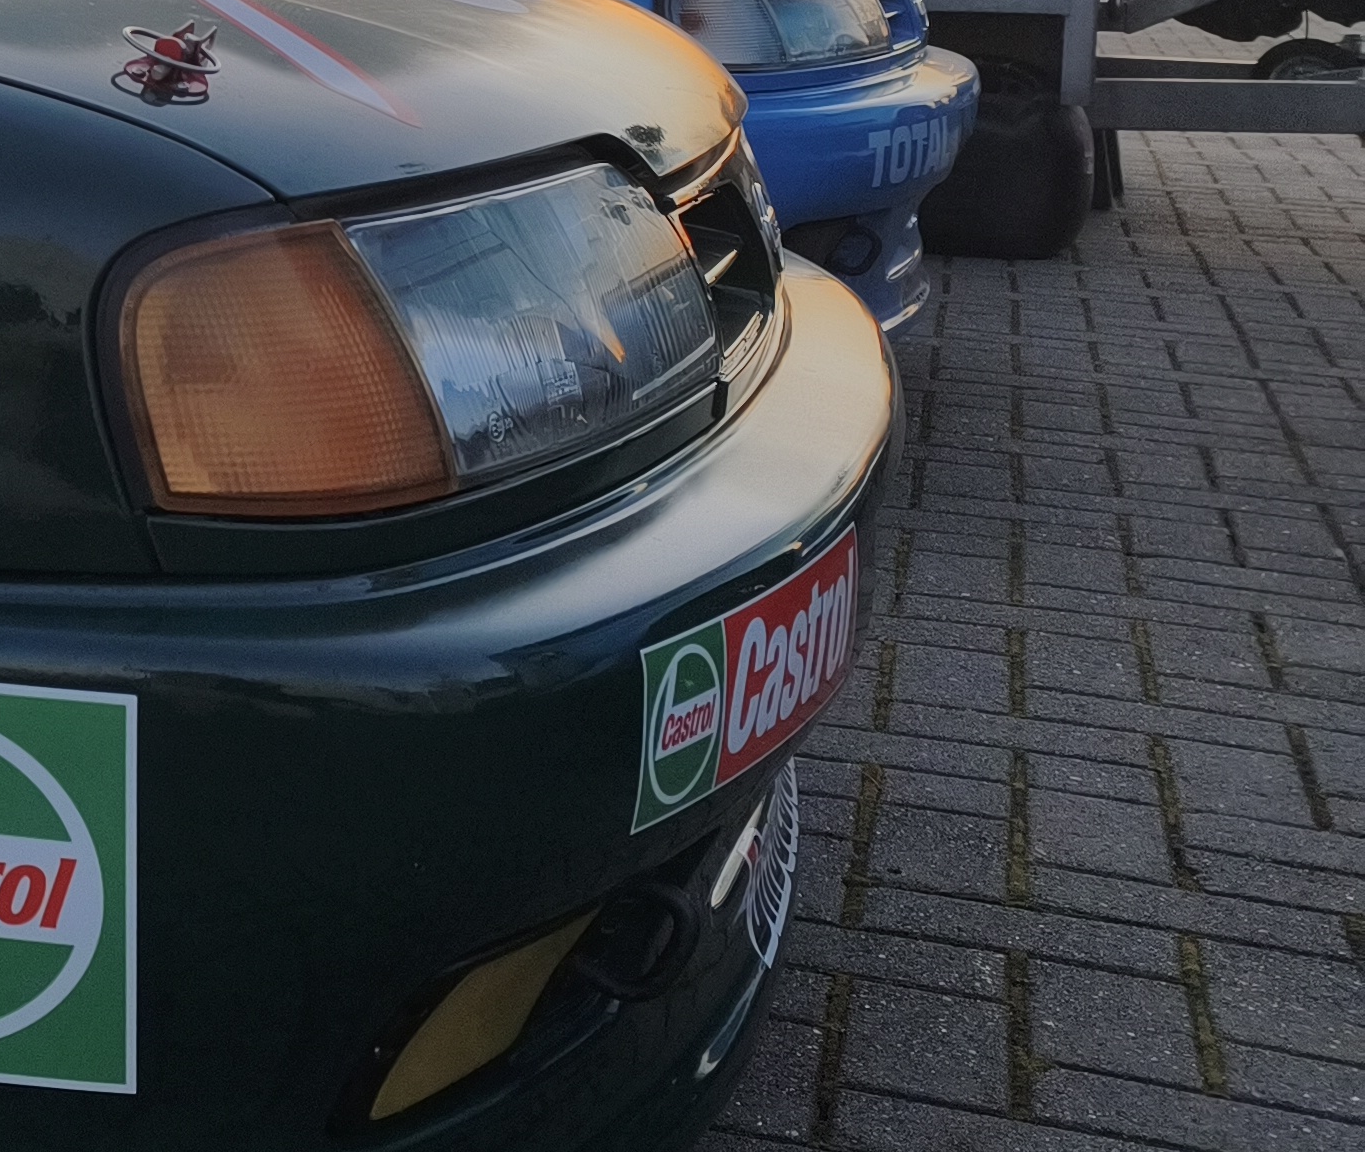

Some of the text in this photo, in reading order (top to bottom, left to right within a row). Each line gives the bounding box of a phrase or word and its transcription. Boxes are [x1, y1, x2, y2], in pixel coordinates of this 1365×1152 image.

[868, 115, 951, 189] TOTAL
[727, 545, 854, 755] Castrol
[661, 692, 718, 751] Castrol
